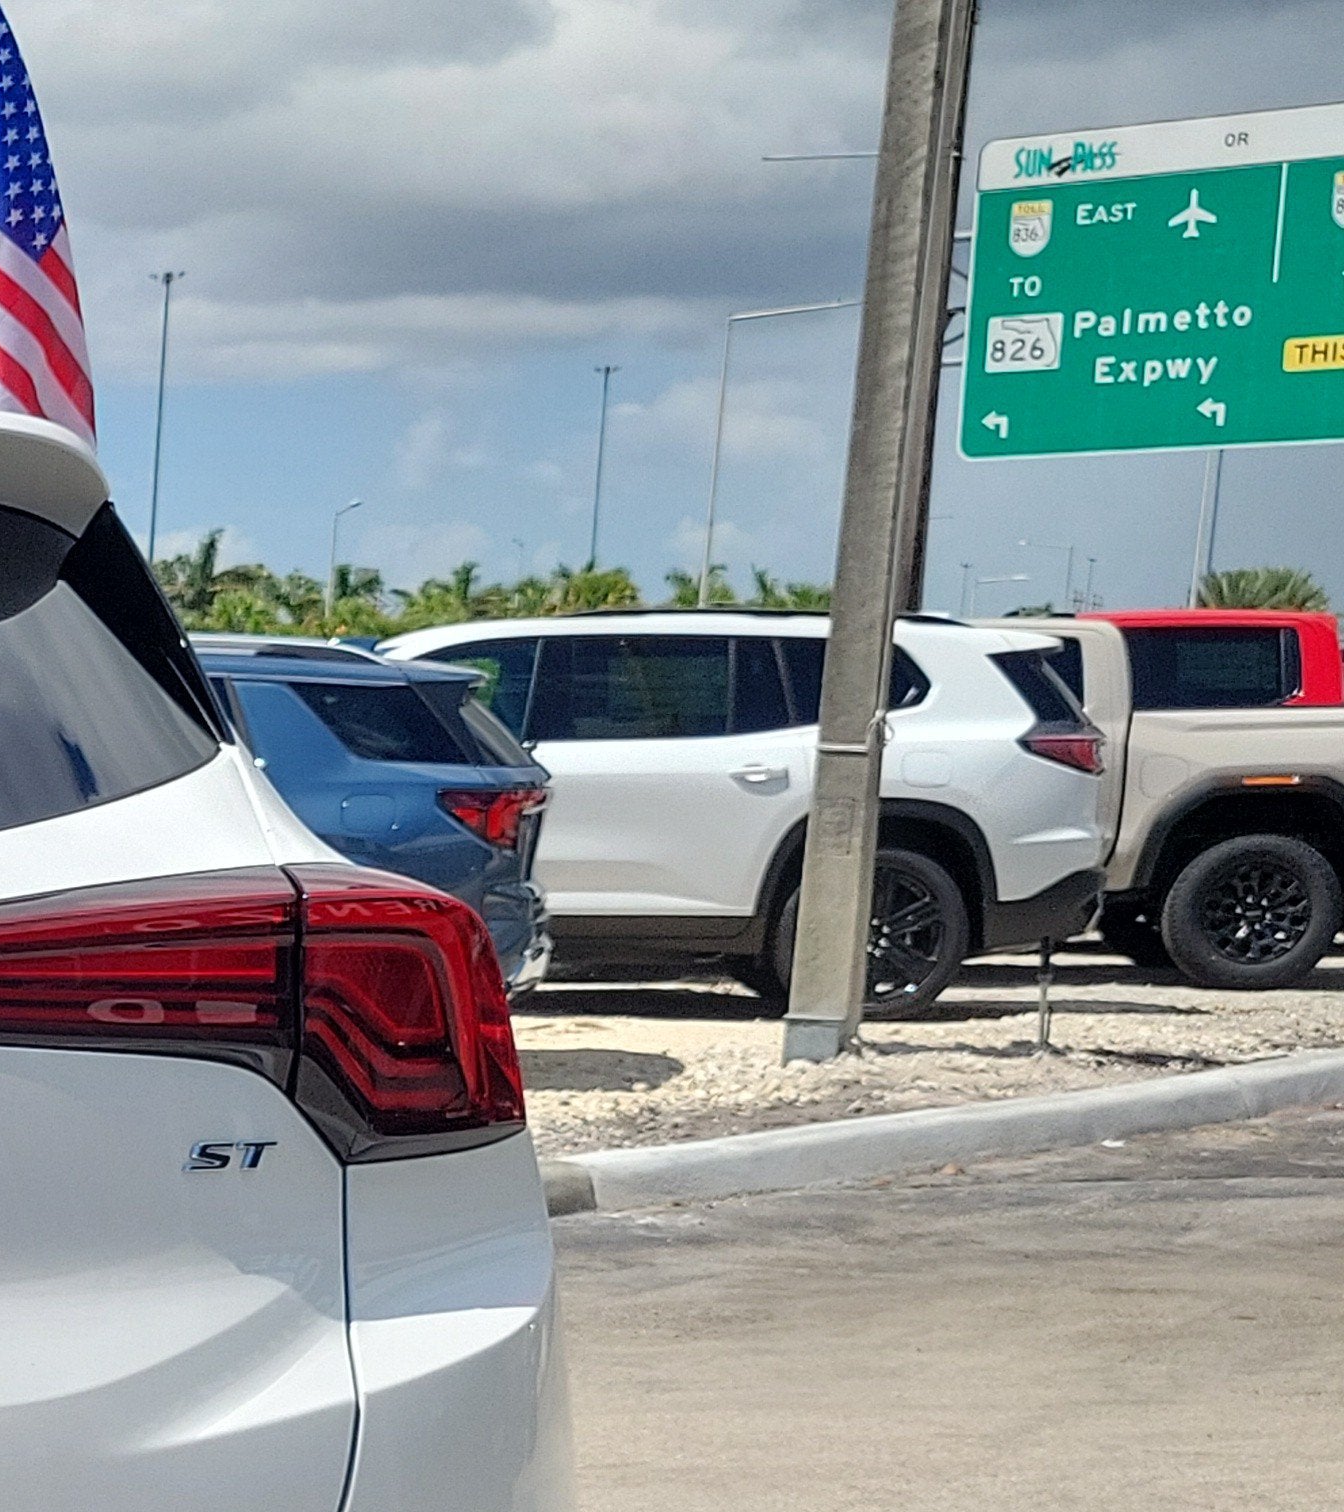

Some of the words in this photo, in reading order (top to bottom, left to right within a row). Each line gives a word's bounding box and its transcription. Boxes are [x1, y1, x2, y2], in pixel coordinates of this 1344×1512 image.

[1225, 133, 1249, 147] OR
[1076, 203, 1137, 226] EAST
[1009, 276, 1042, 297] TO
[990, 337, 1045, 363] 826
[1073, 299, 1253, 339] Palmetto
[1093, 355, 1218, 387] Expwy
[181, 1141, 278, 1172] ST
